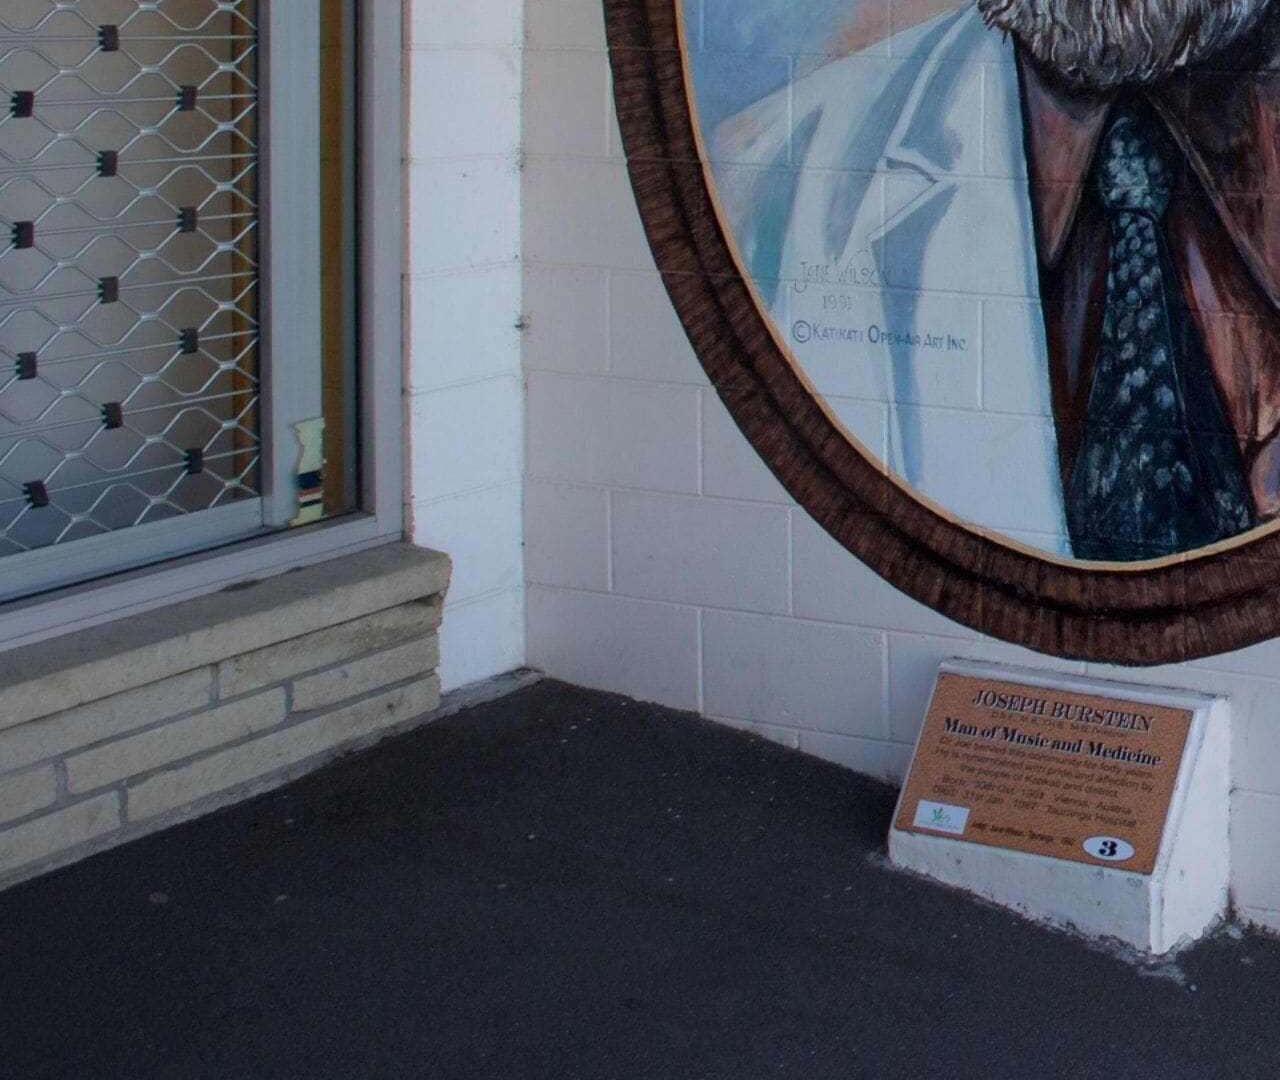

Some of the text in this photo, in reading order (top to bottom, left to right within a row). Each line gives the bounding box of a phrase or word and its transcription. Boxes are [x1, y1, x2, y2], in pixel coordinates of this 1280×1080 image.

[923, 334, 944, 349] ART
[971, 688, 1047, 716] JOSEPH
[1049, 700, 1155, 733] BURSTEIN
[942, 716, 980, 736] Man
[979, 722, 999, 740] of
[999, 726, 1051, 748] Music
[1050, 734, 1083, 753] and
[1084, 739, 1163, 766] Medicine
[960, 752, 1023, 770] remembered
[1024, 762, 1045, 774] with
[1046, 766, 1073, 778] pride
[1074, 770, 1095, 782] and
[1095, 774, 1140, 789] affection
[1140, 781, 1155, 792] by
[1008, 747, 1026, 758] this
[1027, 750, 1082, 767] community
[1082, 759, 1098, 770] for
[1098, 762, 1122, 774] forty
[959, 763, 976, 774] the
[976, 766, 1011, 780] people
[1062, 780, 1083, 792] and
[1093, 812, 1137, 828] Hospital
[1094, 800, 1133, 815] Austria
[1097, 839, 1119, 857] 3
